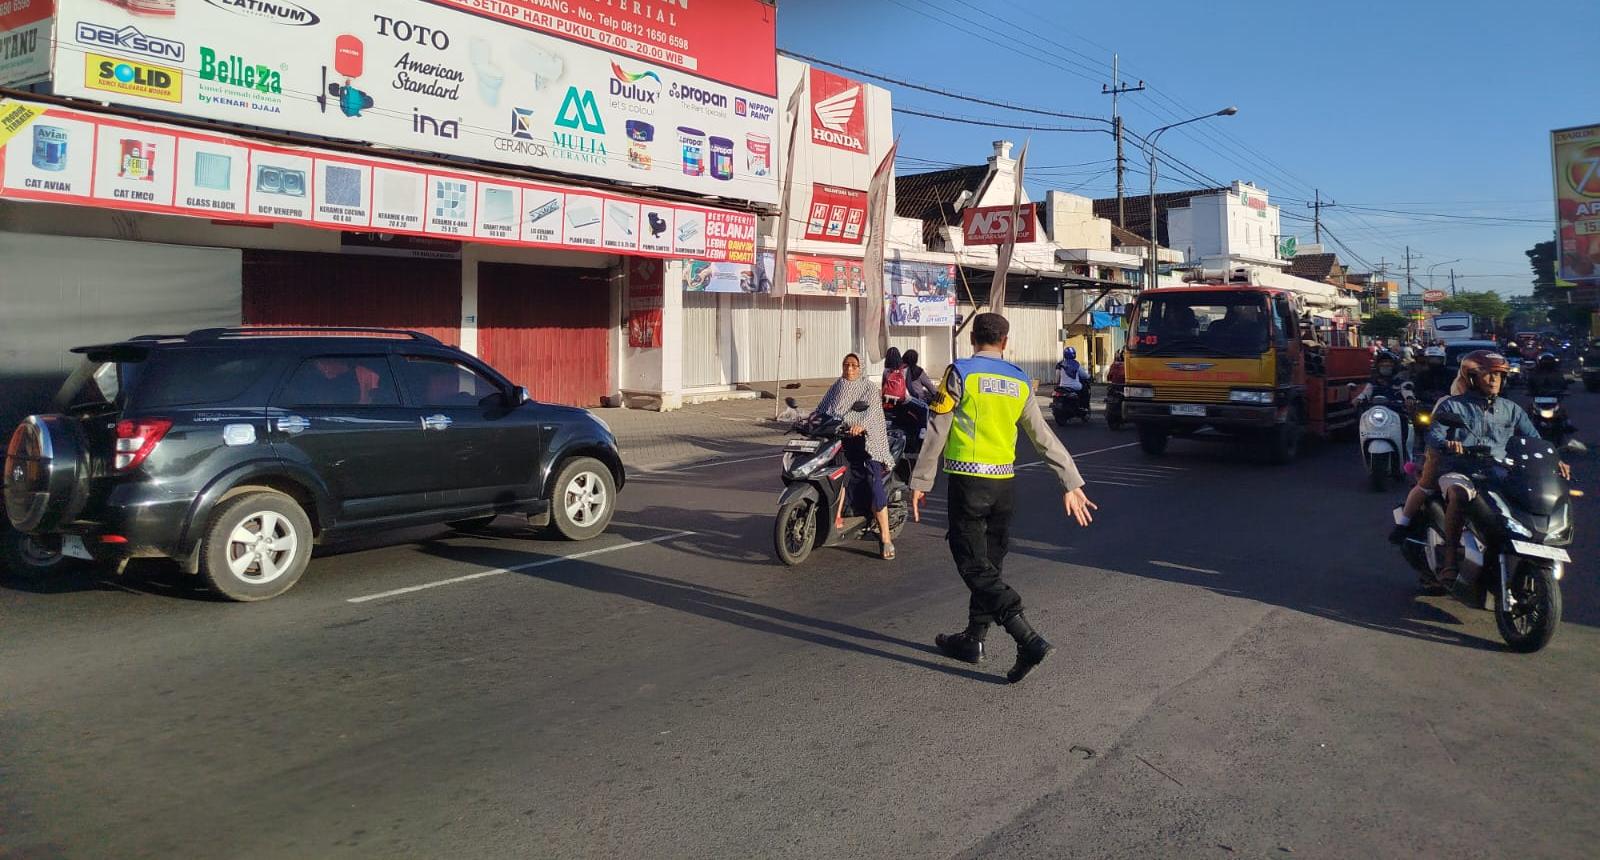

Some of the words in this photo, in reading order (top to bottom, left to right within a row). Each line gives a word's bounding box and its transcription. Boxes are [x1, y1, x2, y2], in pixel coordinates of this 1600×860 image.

[374, 14, 449, 50] TOTO
[472, 0, 519, 17] SETIAP
[523, 10, 553, 27] HARI
[556, 19, 595, 39] PUKUL
[598, 33, 627, 48] 07.00
[636, 43, 663, 58] 20.00
[665, 51, 684, 64] WIB
[578, 7, 595, 22] No.
[599, 13, 619, 30] Telp
[621, 20, 643, 36] 0812
[647, 28, 667, 43] 1650
[669, 34, 689, 50] 6598
[99, 61, 171, 88] SOLID
[199, 46, 282, 94] Belleza
[394, 51, 465, 82] American
[392, 71, 460, 100] Standard
[610, 77, 656, 104] Dulux
[198, 93, 212, 103] by
[212, 96, 249, 108] KENARI
[252, 103, 281, 113] DJAJA
[681, 85, 727, 109] propan
[749, 102, 774, 115] NIPPON
[750, 111, 770, 121] PAINT
[38, 128, 67, 140] Avian
[413, 107, 459, 139] ina
[494, 137, 549, 158] CERANOSA
[553, 131, 607, 156] MULIA
[813, 127, 863, 150] HONDA
[552, 150, 607, 165] CERAMICS
[25, 178, 43, 188] CAT
[44, 179, 71, 191] AVIAN
[114, 189, 129, 198] CAT
[131, 190, 154, 201] EMCO
[186, 197, 210, 208] GLASS
[212, 199, 236, 210] BLOCK
[706, 221, 754, 240] BELANJA
[706, 238, 727, 249] LEBIH
[727, 239, 754, 251] BANYAK
[706, 248, 726, 259] LEBIH
